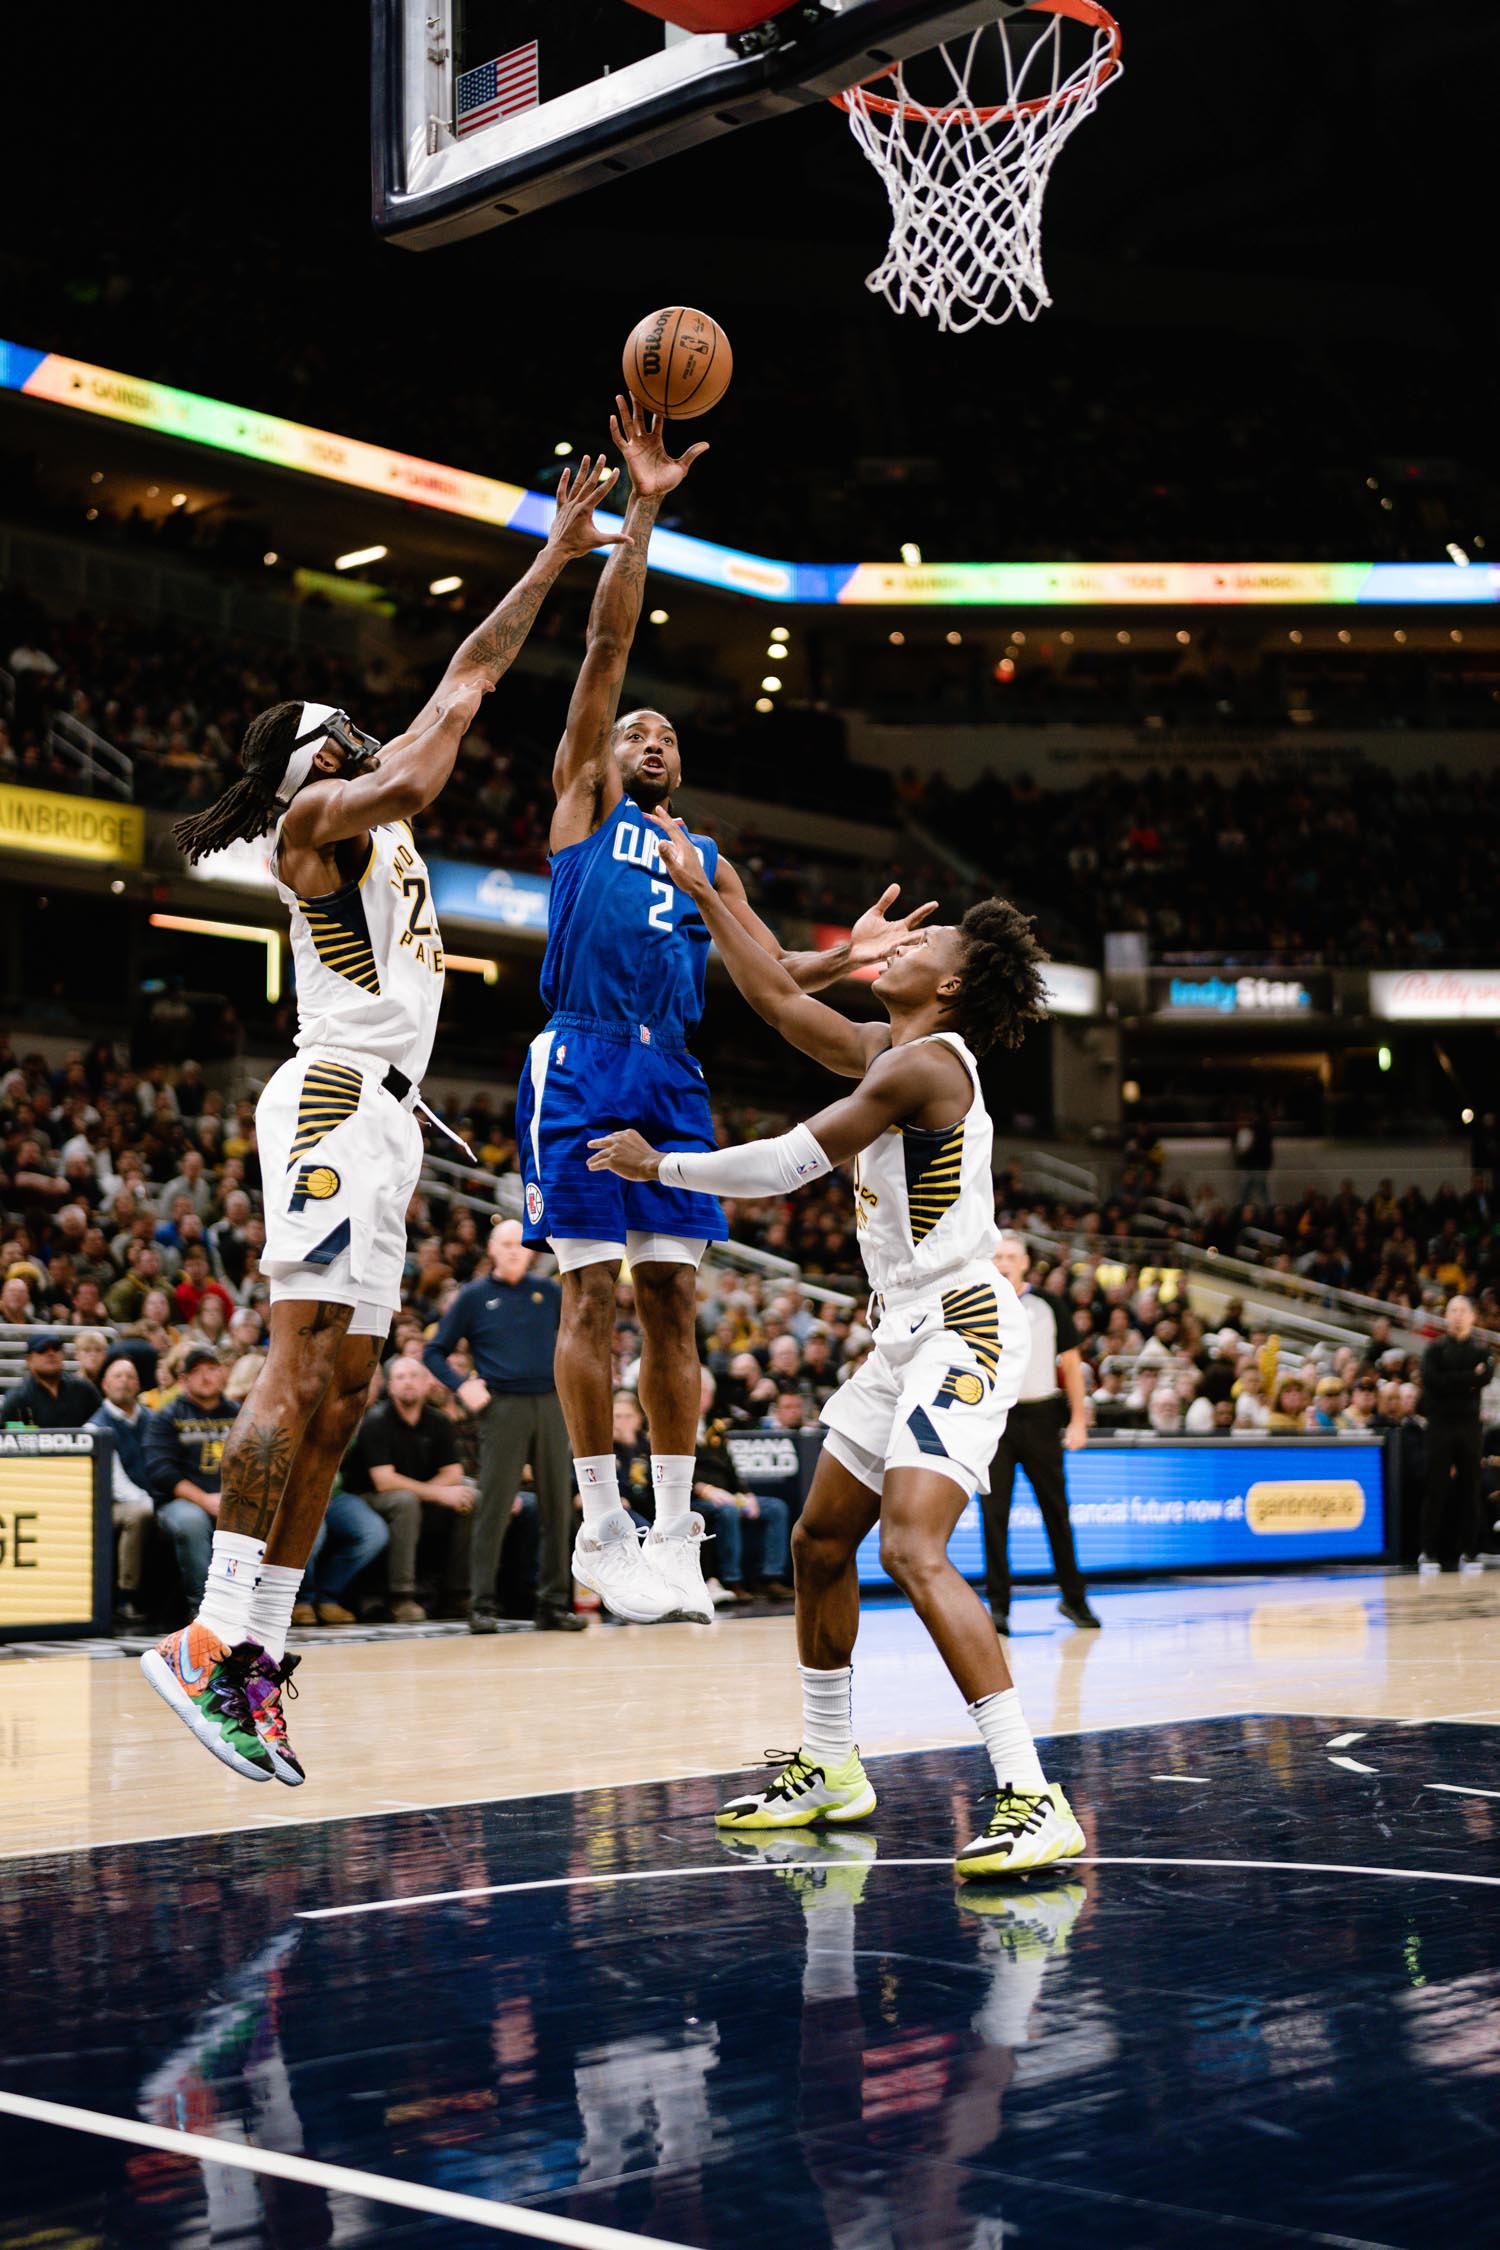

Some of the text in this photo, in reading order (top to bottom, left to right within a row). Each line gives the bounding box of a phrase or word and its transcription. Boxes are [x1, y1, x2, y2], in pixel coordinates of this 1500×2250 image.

[643, 309, 674, 376] Wilson
[402, 878, 440, 936] 2
[648, 879, 674, 932] 2
[39, 1434, 95, 1453] BOLD
